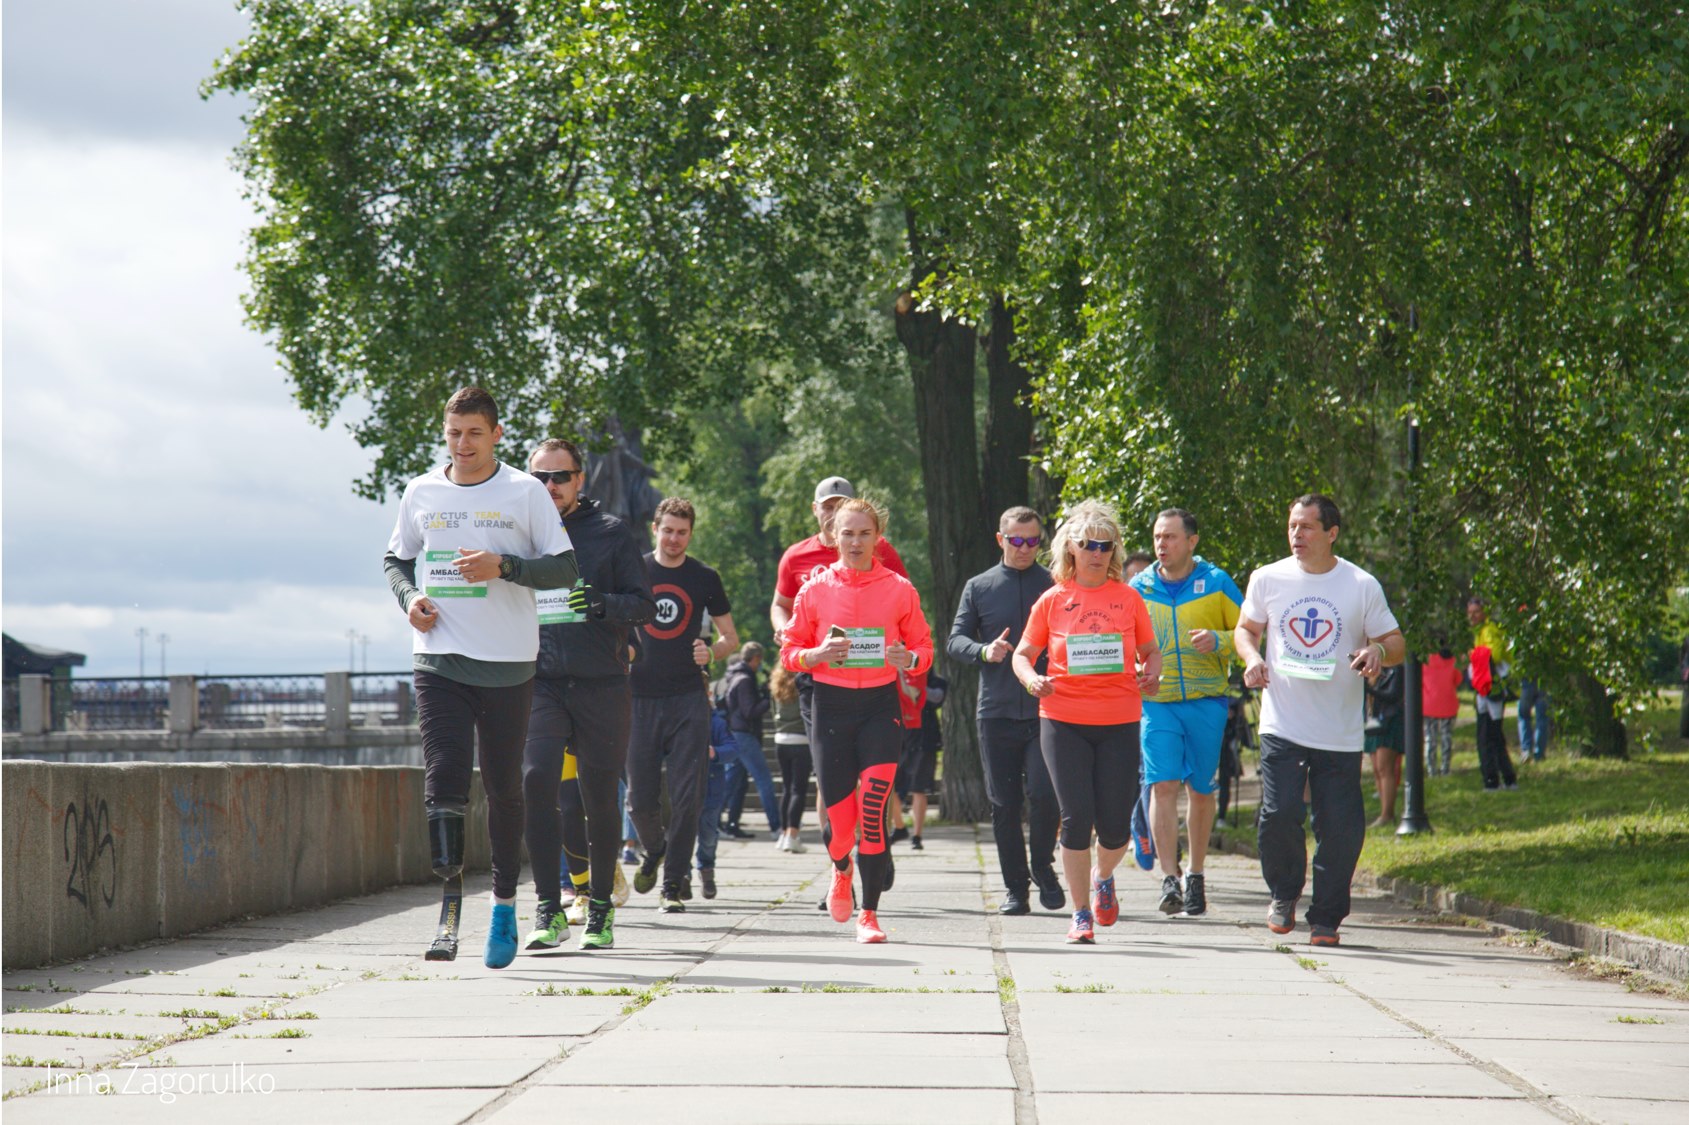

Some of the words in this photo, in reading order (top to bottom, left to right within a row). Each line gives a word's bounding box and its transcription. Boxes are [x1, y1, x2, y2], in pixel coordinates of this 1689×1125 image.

[421, 511, 468, 521] INVICTUS
[474, 511, 500, 519] TEAM
[423, 520, 460, 530] GAMES
[474, 519, 514, 529] UKRAINE
[1284, 640, 1302, 657] ЦЕНТР
[1332, 607, 1339, 616] ТА
[1072, 648, 1119, 657] АМБАСАДОР
[863, 777, 890, 843] PUMA
